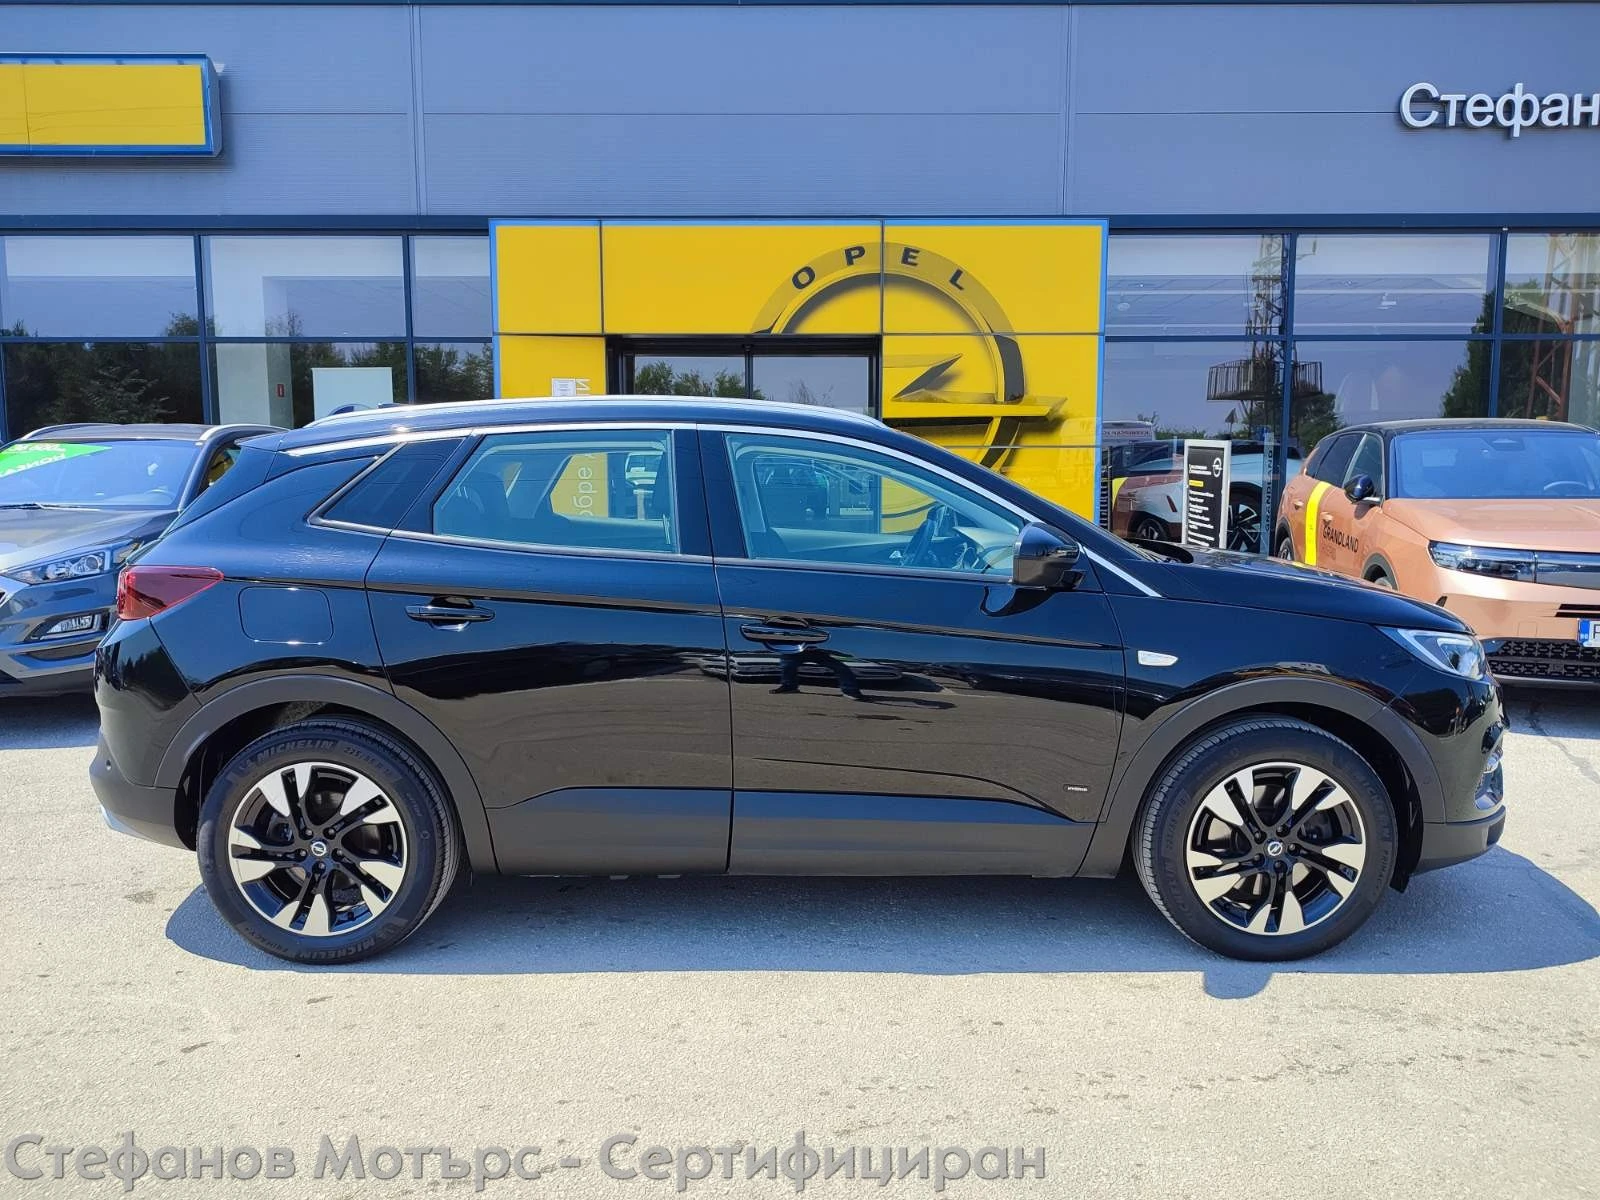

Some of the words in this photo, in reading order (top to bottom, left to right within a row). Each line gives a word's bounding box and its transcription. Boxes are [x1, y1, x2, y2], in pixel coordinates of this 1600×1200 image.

[1401, 82, 1600, 138] Стефан
[791, 245, 965, 291] OPEL
[1322, 526, 1359, 553] GRANDLAND
[256, 739, 335, 766] MICHELIN
